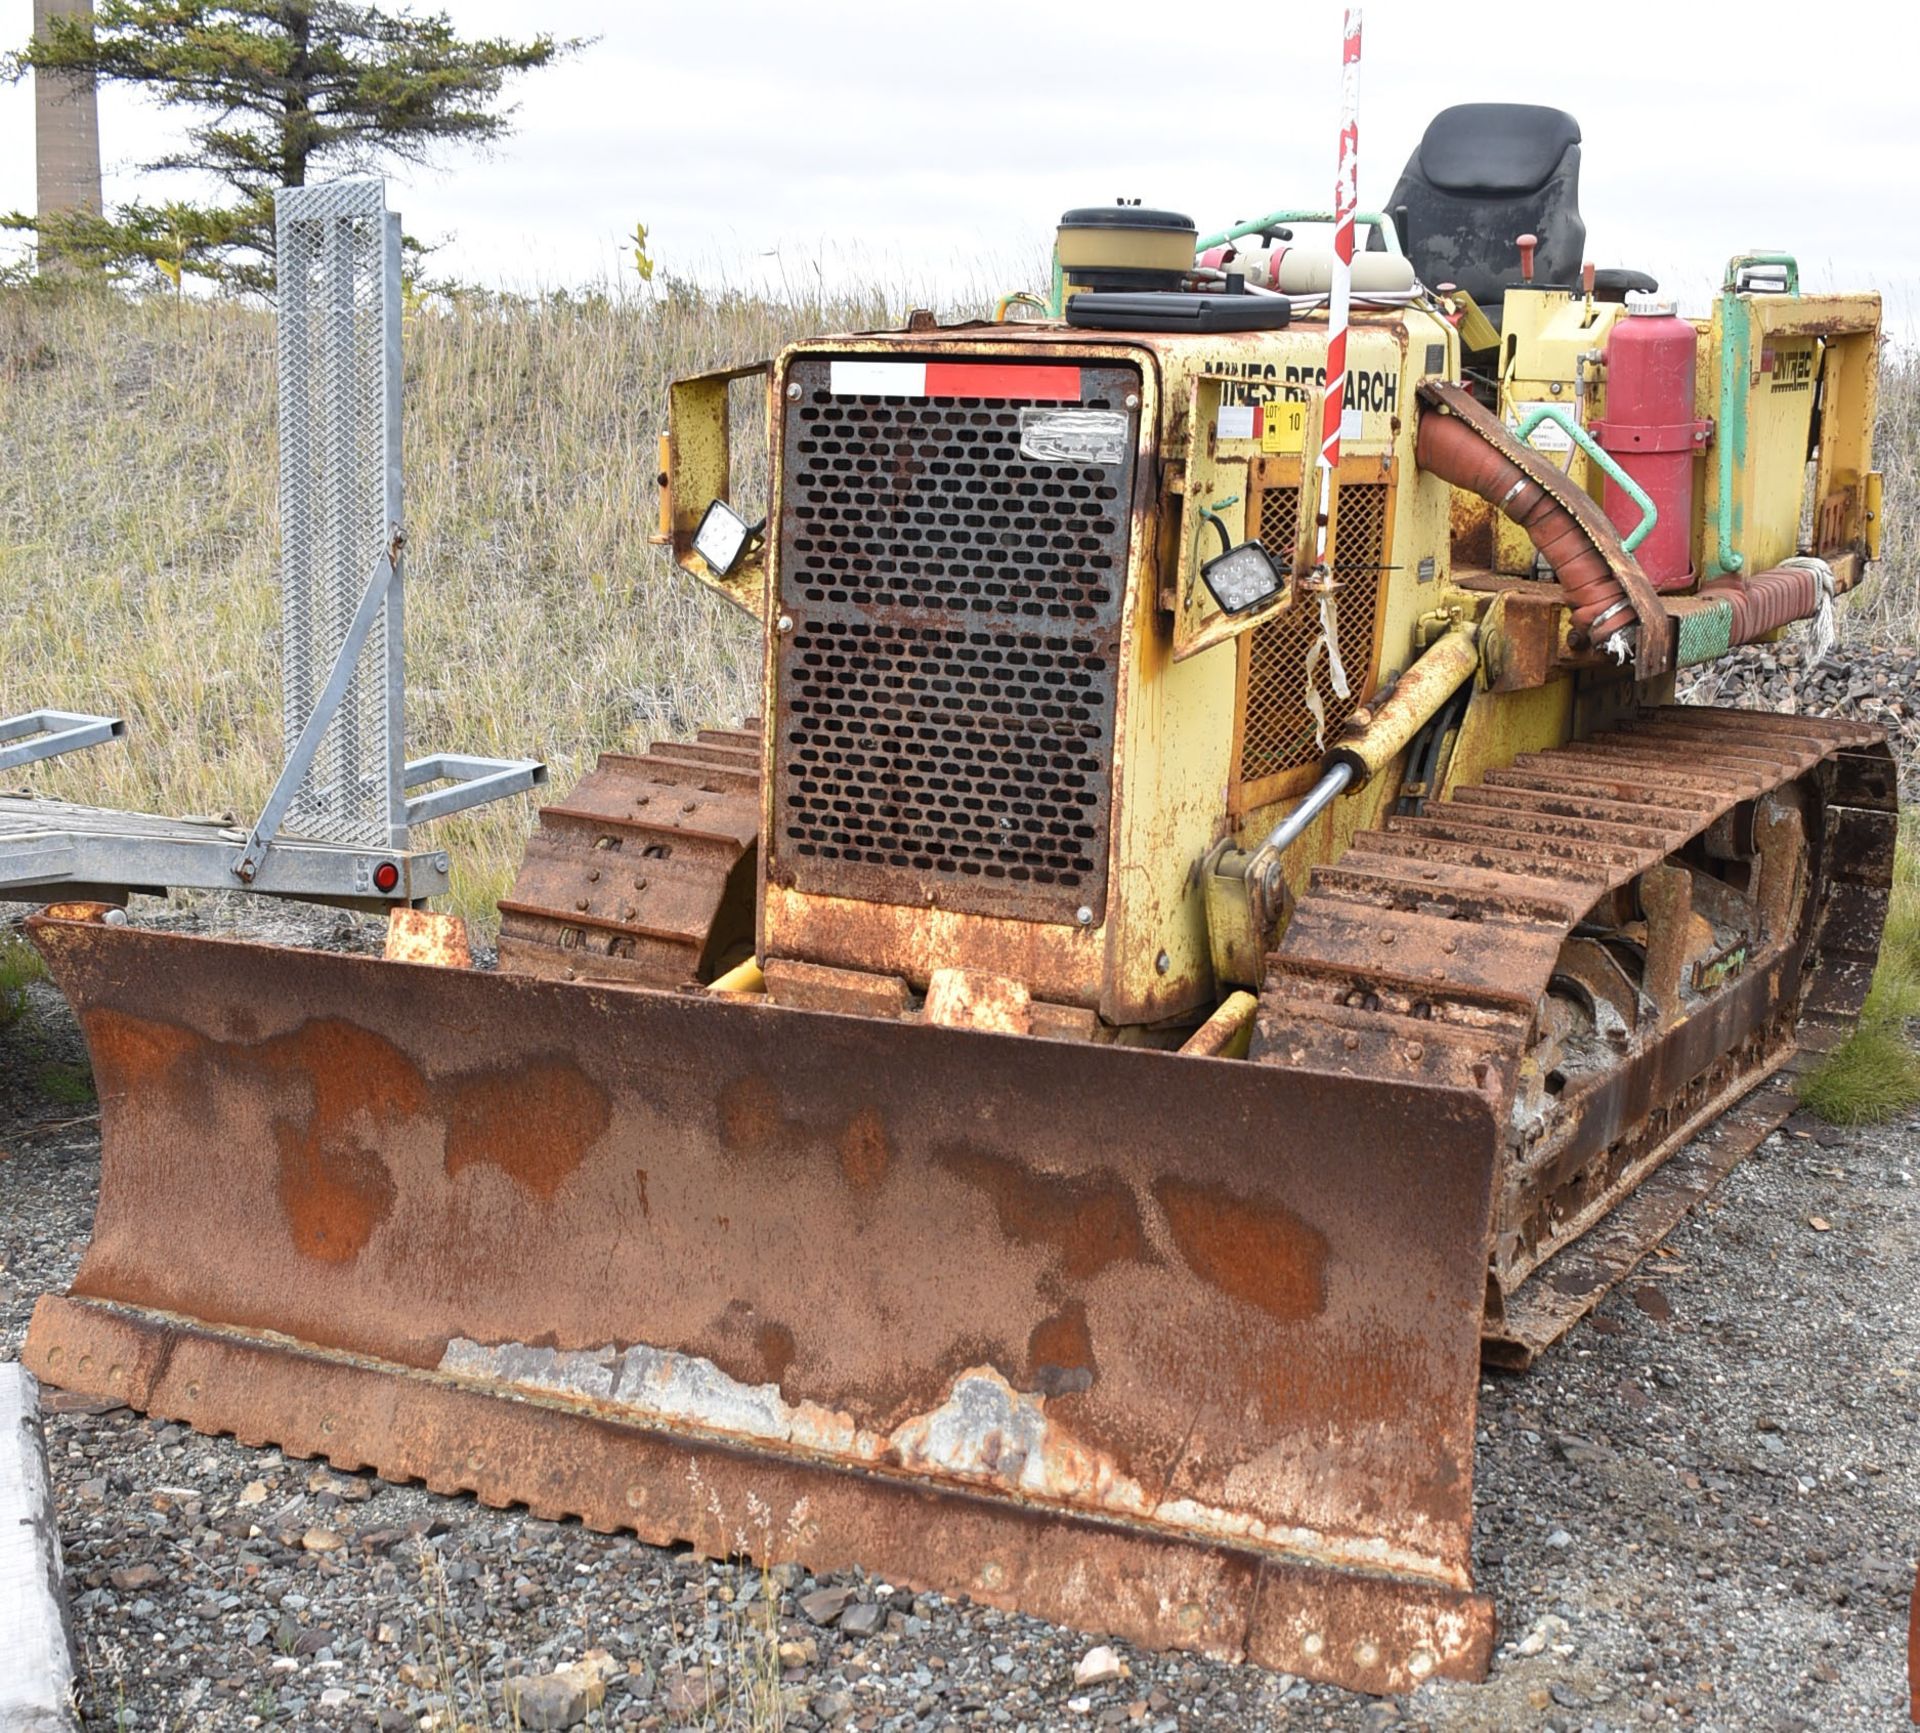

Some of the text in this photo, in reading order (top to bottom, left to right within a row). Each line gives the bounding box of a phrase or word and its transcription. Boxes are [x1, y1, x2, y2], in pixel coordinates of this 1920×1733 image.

[1284, 365, 1396, 413] REARCH
[1265, 404, 1278, 418] LOT
[1289, 412, 1301, 431] 10
